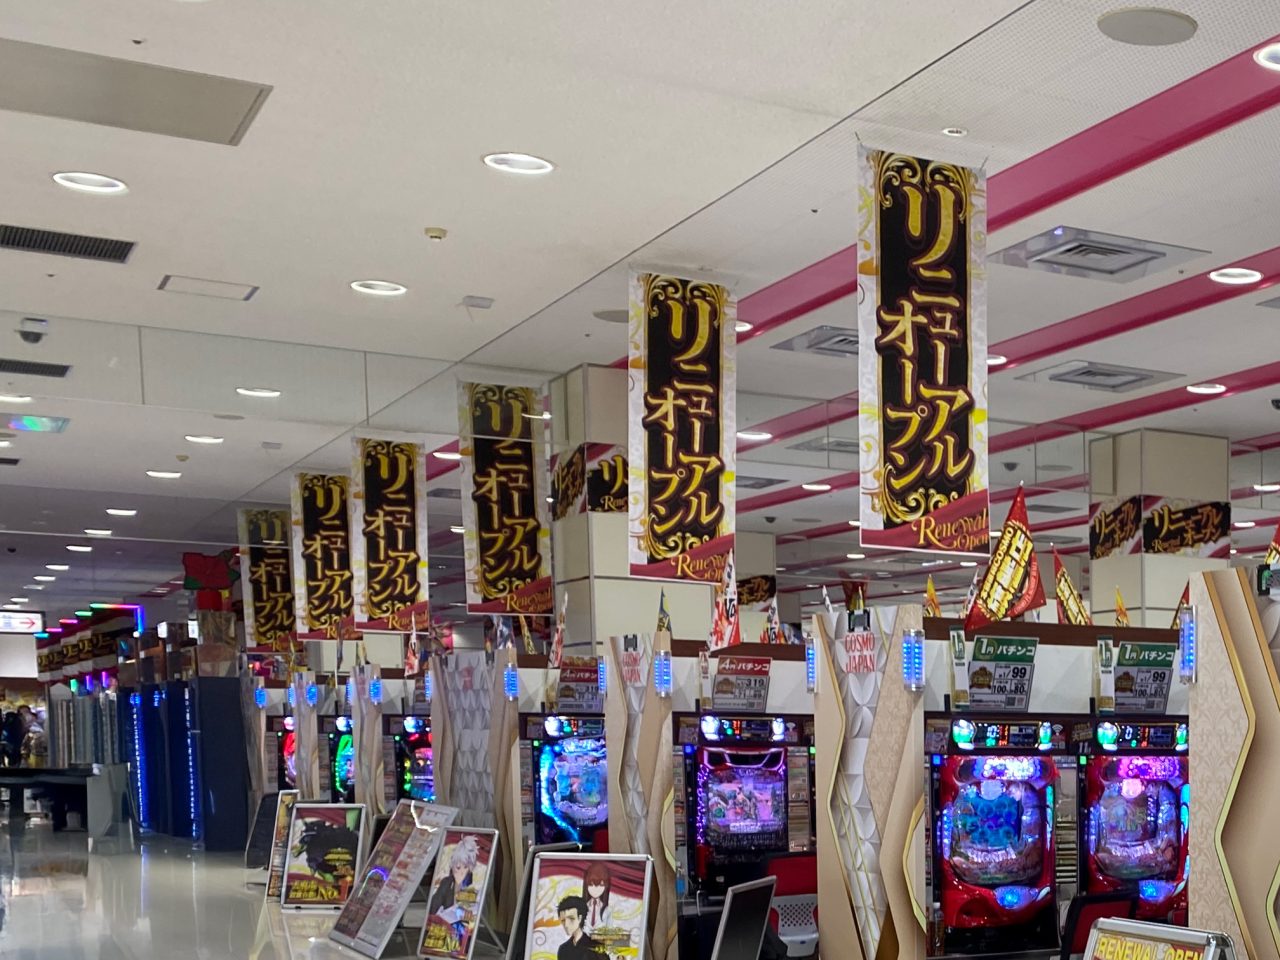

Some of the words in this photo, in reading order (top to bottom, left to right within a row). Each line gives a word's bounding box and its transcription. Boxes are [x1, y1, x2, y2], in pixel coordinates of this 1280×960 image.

[902, 183, 971, 480] リニューアル
[667, 299, 721, 526] リニューアル
[879, 300, 929, 491] オープン
[487, 399, 541, 572] リニューアル
[646, 388, 686, 534] オープン
[316, 484, 352, 608] リニューアル
[364, 510, 393, 602] オープン
[379, 453, 419, 596] リニューアル
[475, 468, 509, 582] オープン
[912, 512, 988, 551] Renewal
[845, 633, 875, 651] COSMO
[846, 654, 875, 673] JAPAN
[980, 639, 994, 654] 1円
[997, 646, 1035, 655] パチンコ
[1124, 644, 1137, 660] 1円
[1140, 651, 1174, 660] パチンコ
